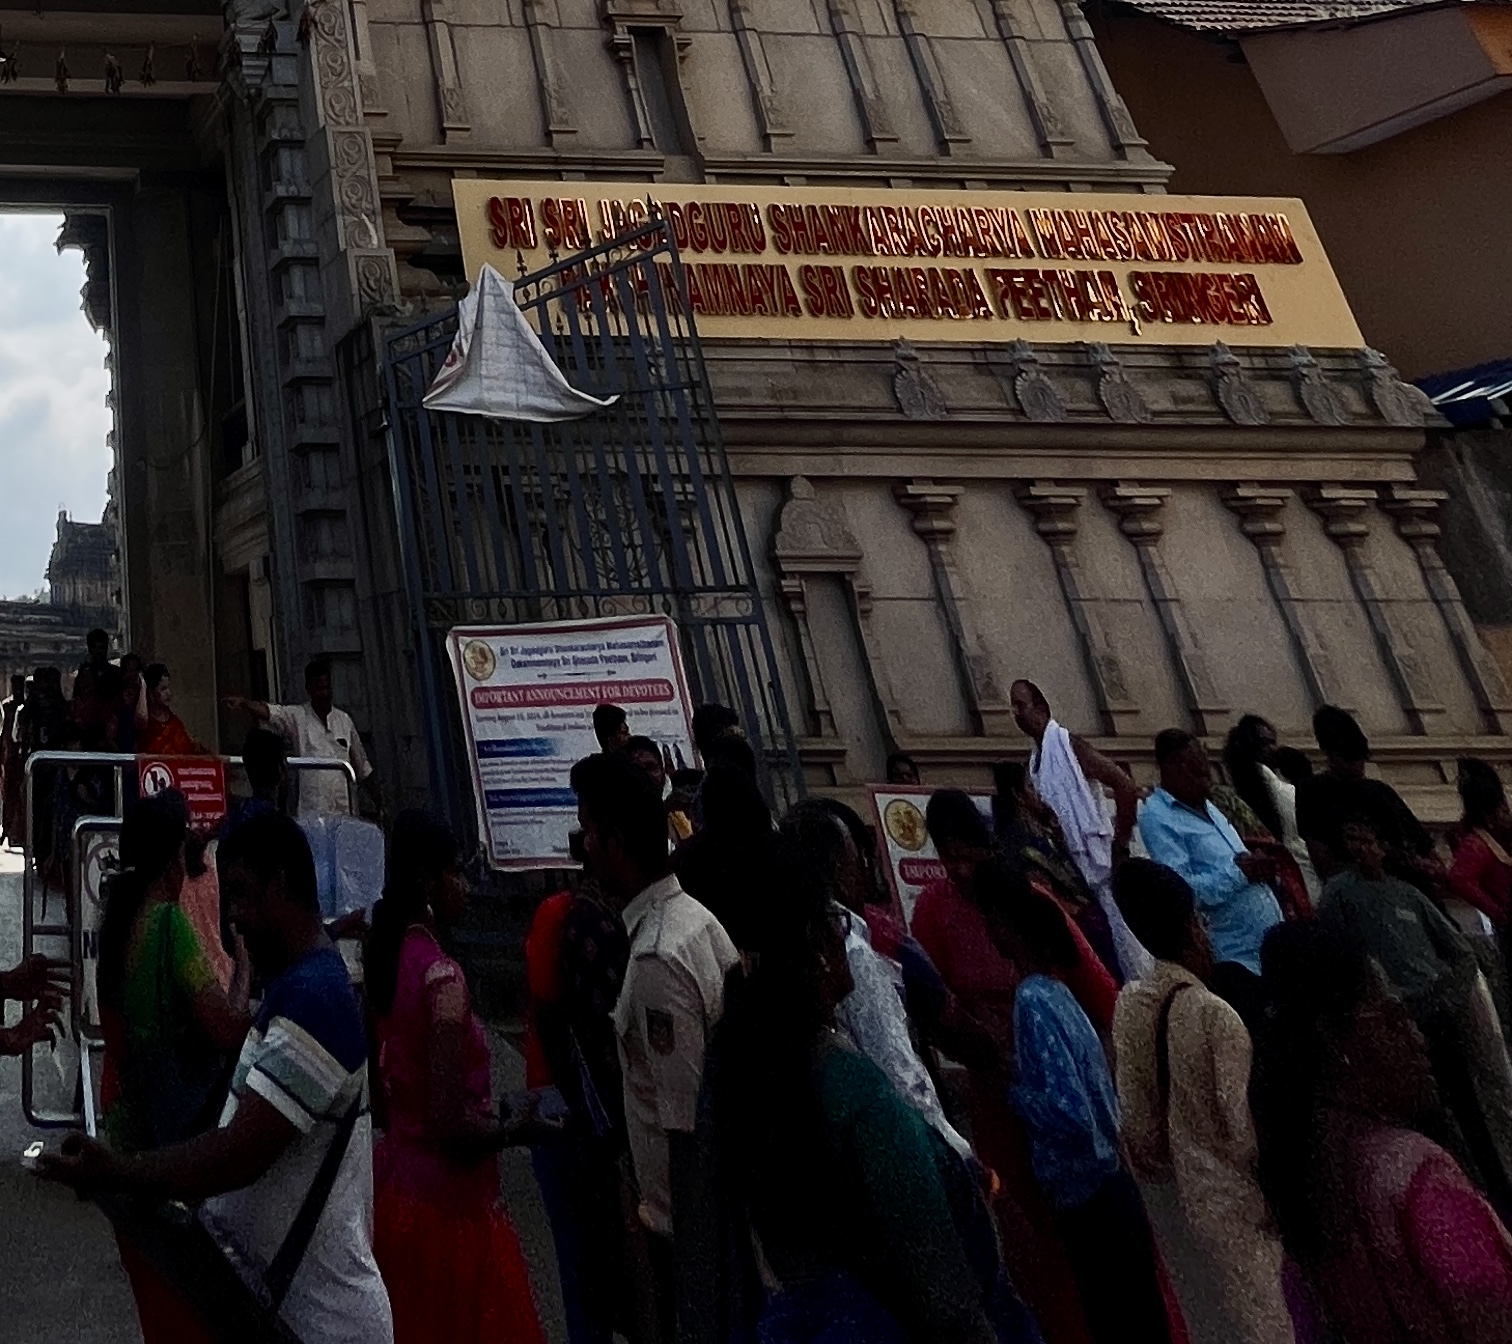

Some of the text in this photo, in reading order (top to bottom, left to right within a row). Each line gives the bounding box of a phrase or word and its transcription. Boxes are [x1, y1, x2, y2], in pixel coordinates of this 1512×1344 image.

[489, 196, 538, 250] SRI
[541, 197, 593, 250] SRI
[768, 203, 1036, 258] SHANKARACHARYA
[800, 264, 855, 318] SRI
[853, 265, 994, 319] SHARADA
[474, 683, 671, 704] IMPORTANT ANNOUNCEMENT FOR DEVOTEES
